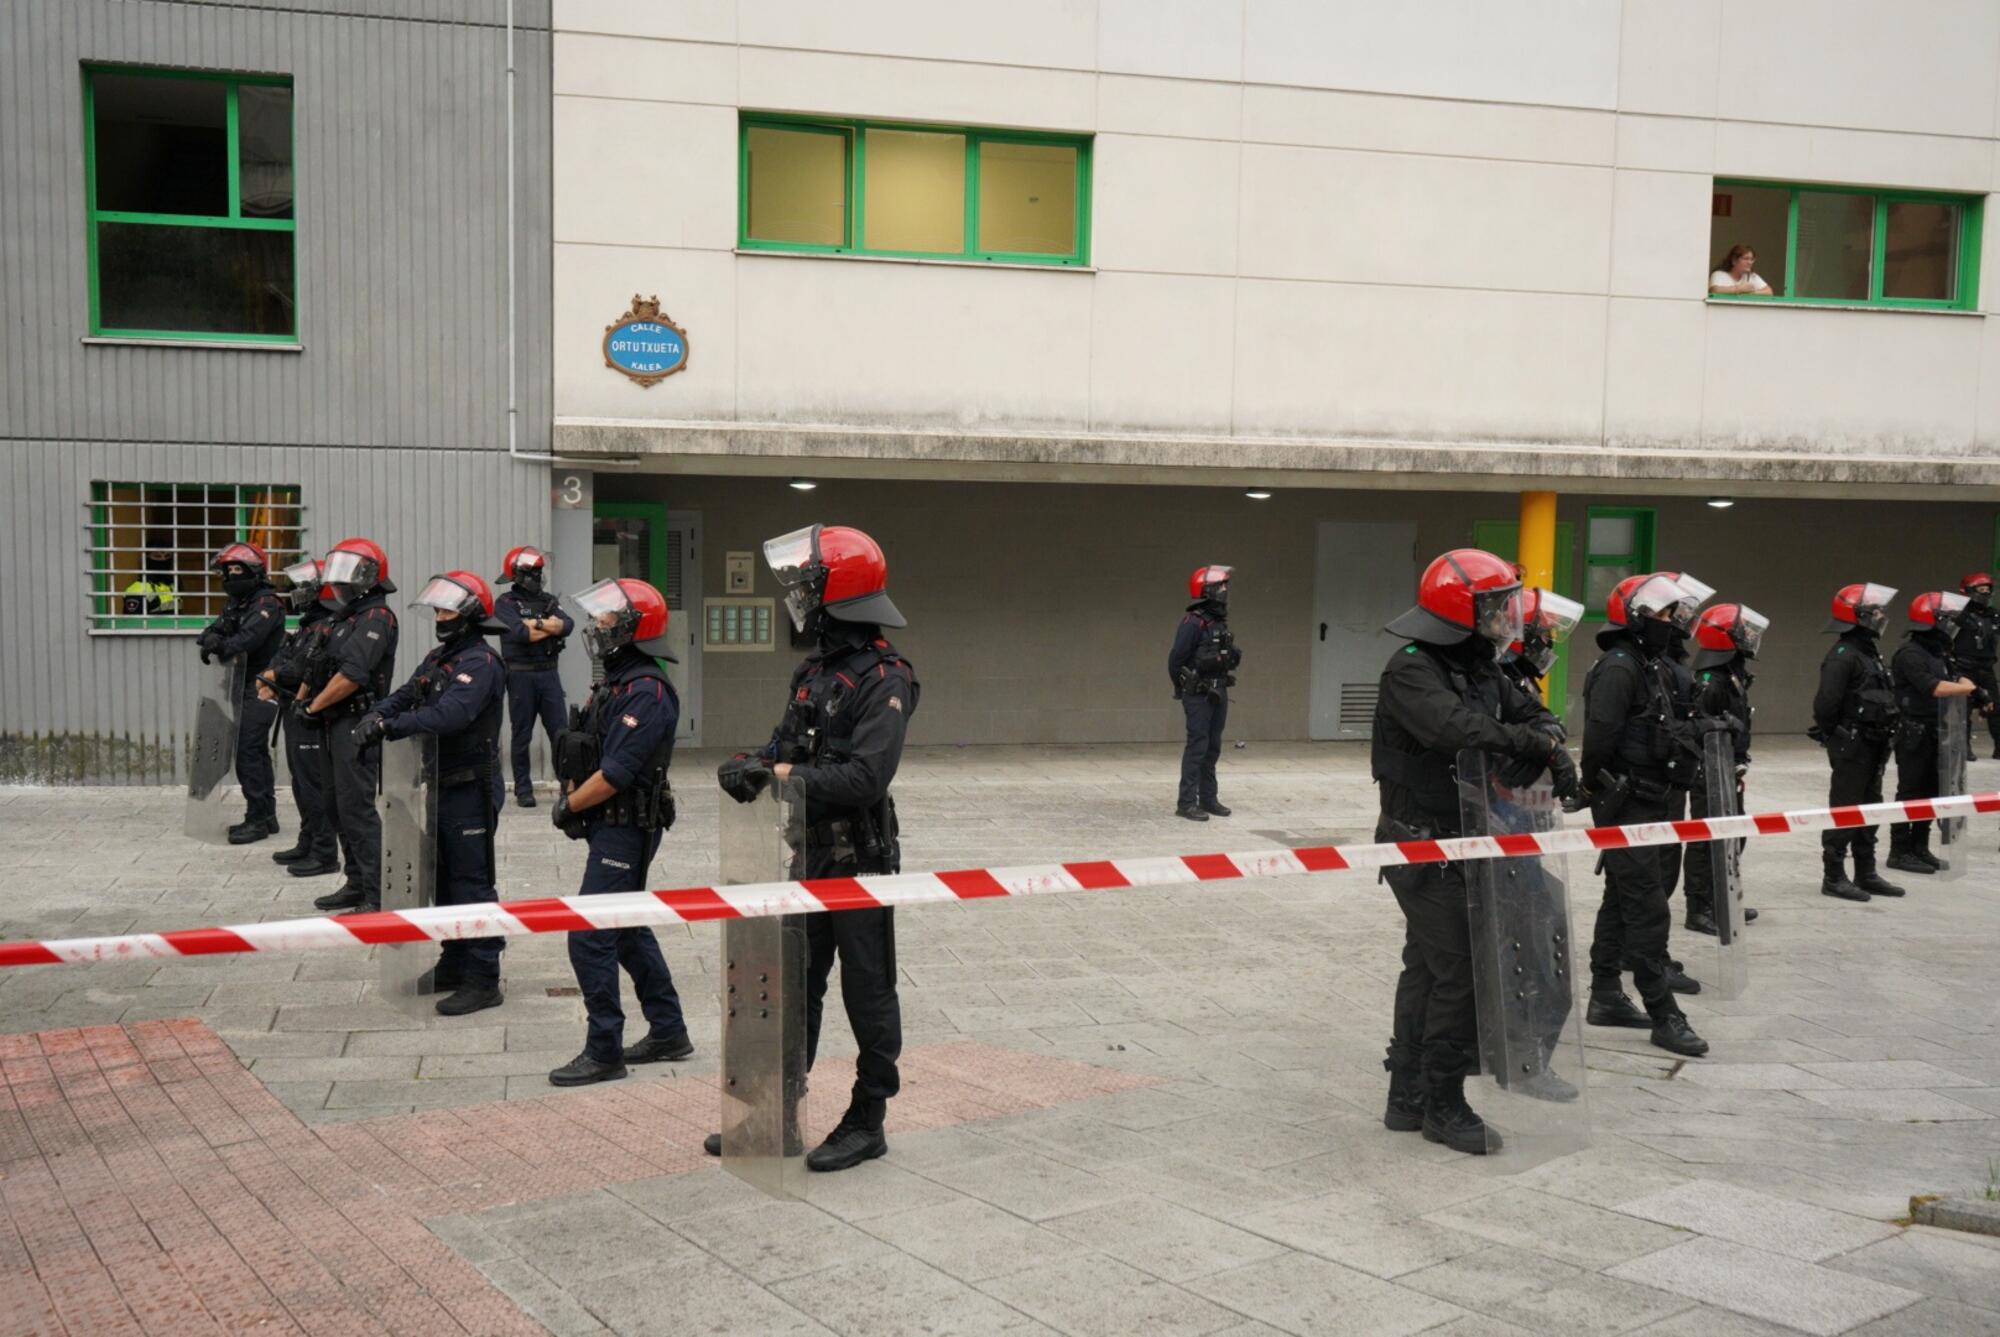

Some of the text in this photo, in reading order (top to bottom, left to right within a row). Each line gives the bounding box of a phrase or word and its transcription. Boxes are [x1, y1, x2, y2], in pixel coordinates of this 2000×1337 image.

[631, 323, 663, 334] CALLE
[611, 340, 679, 354] ORTUTXUETA
[631, 362, 662, 371] KALEA
[563, 476, 582, 503] 3
